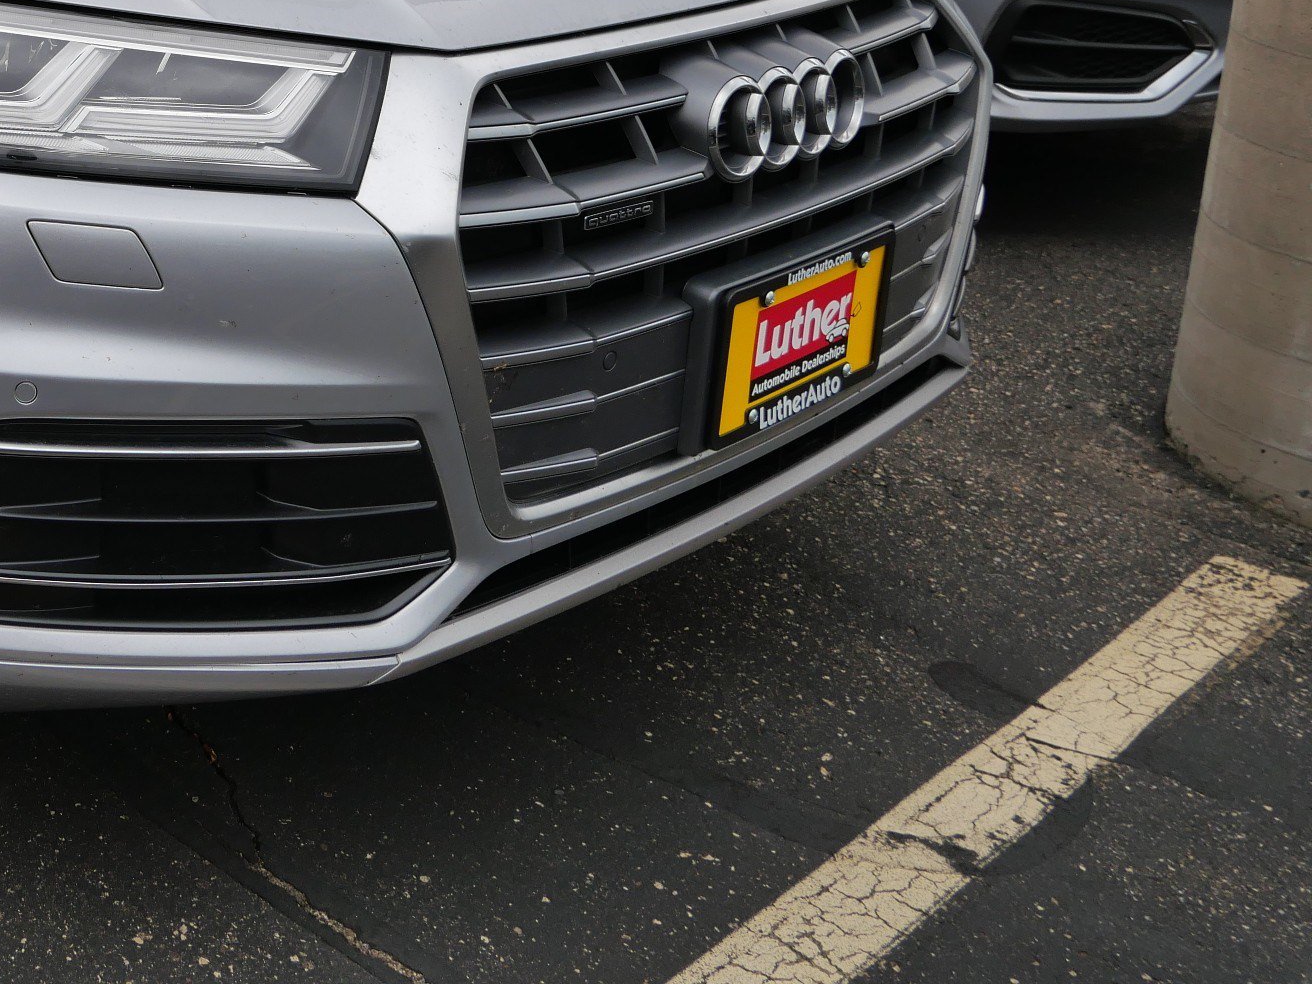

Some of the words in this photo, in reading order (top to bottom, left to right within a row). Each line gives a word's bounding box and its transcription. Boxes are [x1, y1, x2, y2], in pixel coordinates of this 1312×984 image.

[588, 204, 652, 227] quattro
[788, 252, 852, 285] LutherAuto.com
[754, 292, 852, 367] Luther
[751, 365, 801, 396] Automobile
[801, 344, 846, 373] Dealerships
[759, 376, 841, 430] LutherAuto
